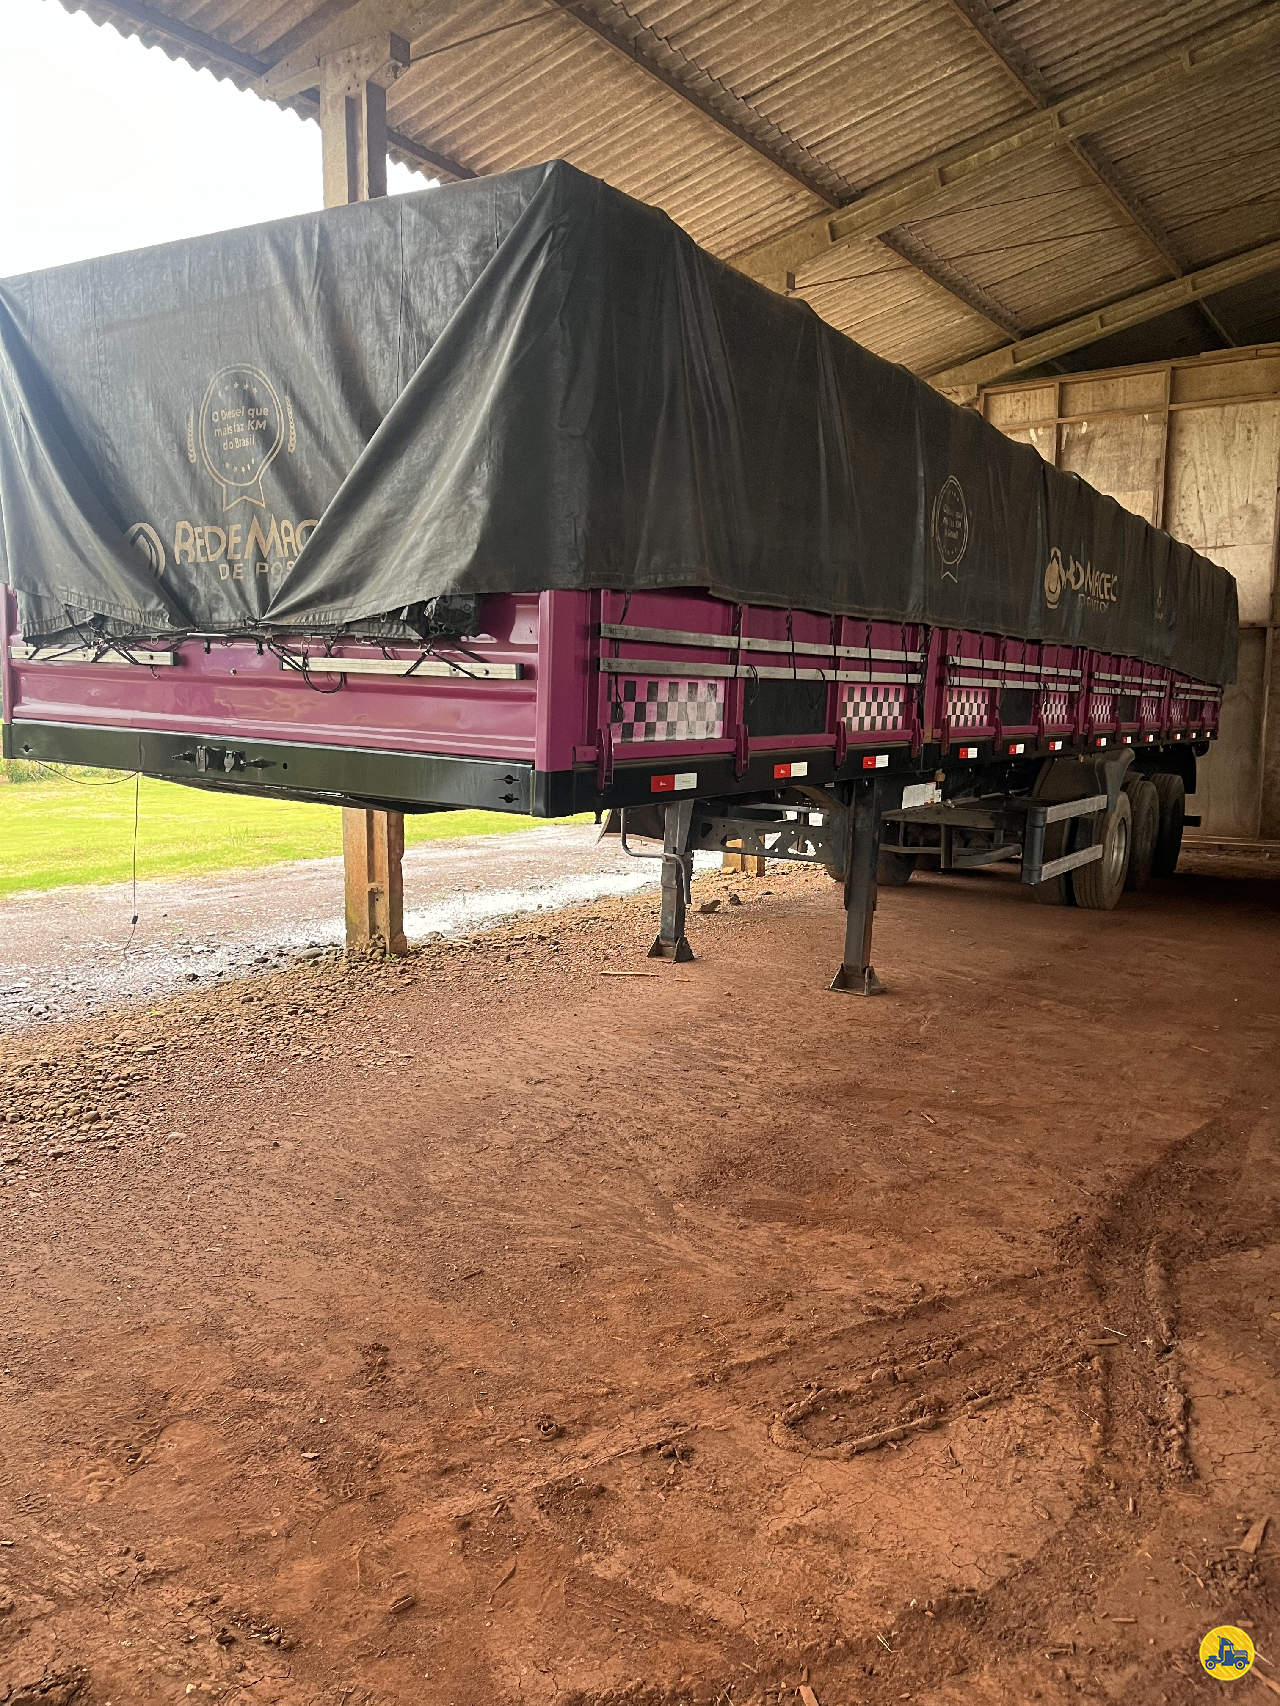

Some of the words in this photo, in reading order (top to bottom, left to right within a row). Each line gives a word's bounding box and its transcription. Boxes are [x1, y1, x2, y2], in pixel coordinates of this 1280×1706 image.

[212, 411, 219, 423] O
[220, 406, 245, 421] Diesel
[247, 407, 269, 419] que
[214, 423, 233, 437] mais
[247, 419, 267, 431] KM
[222, 439, 234, 451] do
[234, 434, 255, 449] Brasil
[218, 562, 244, 581] DE
